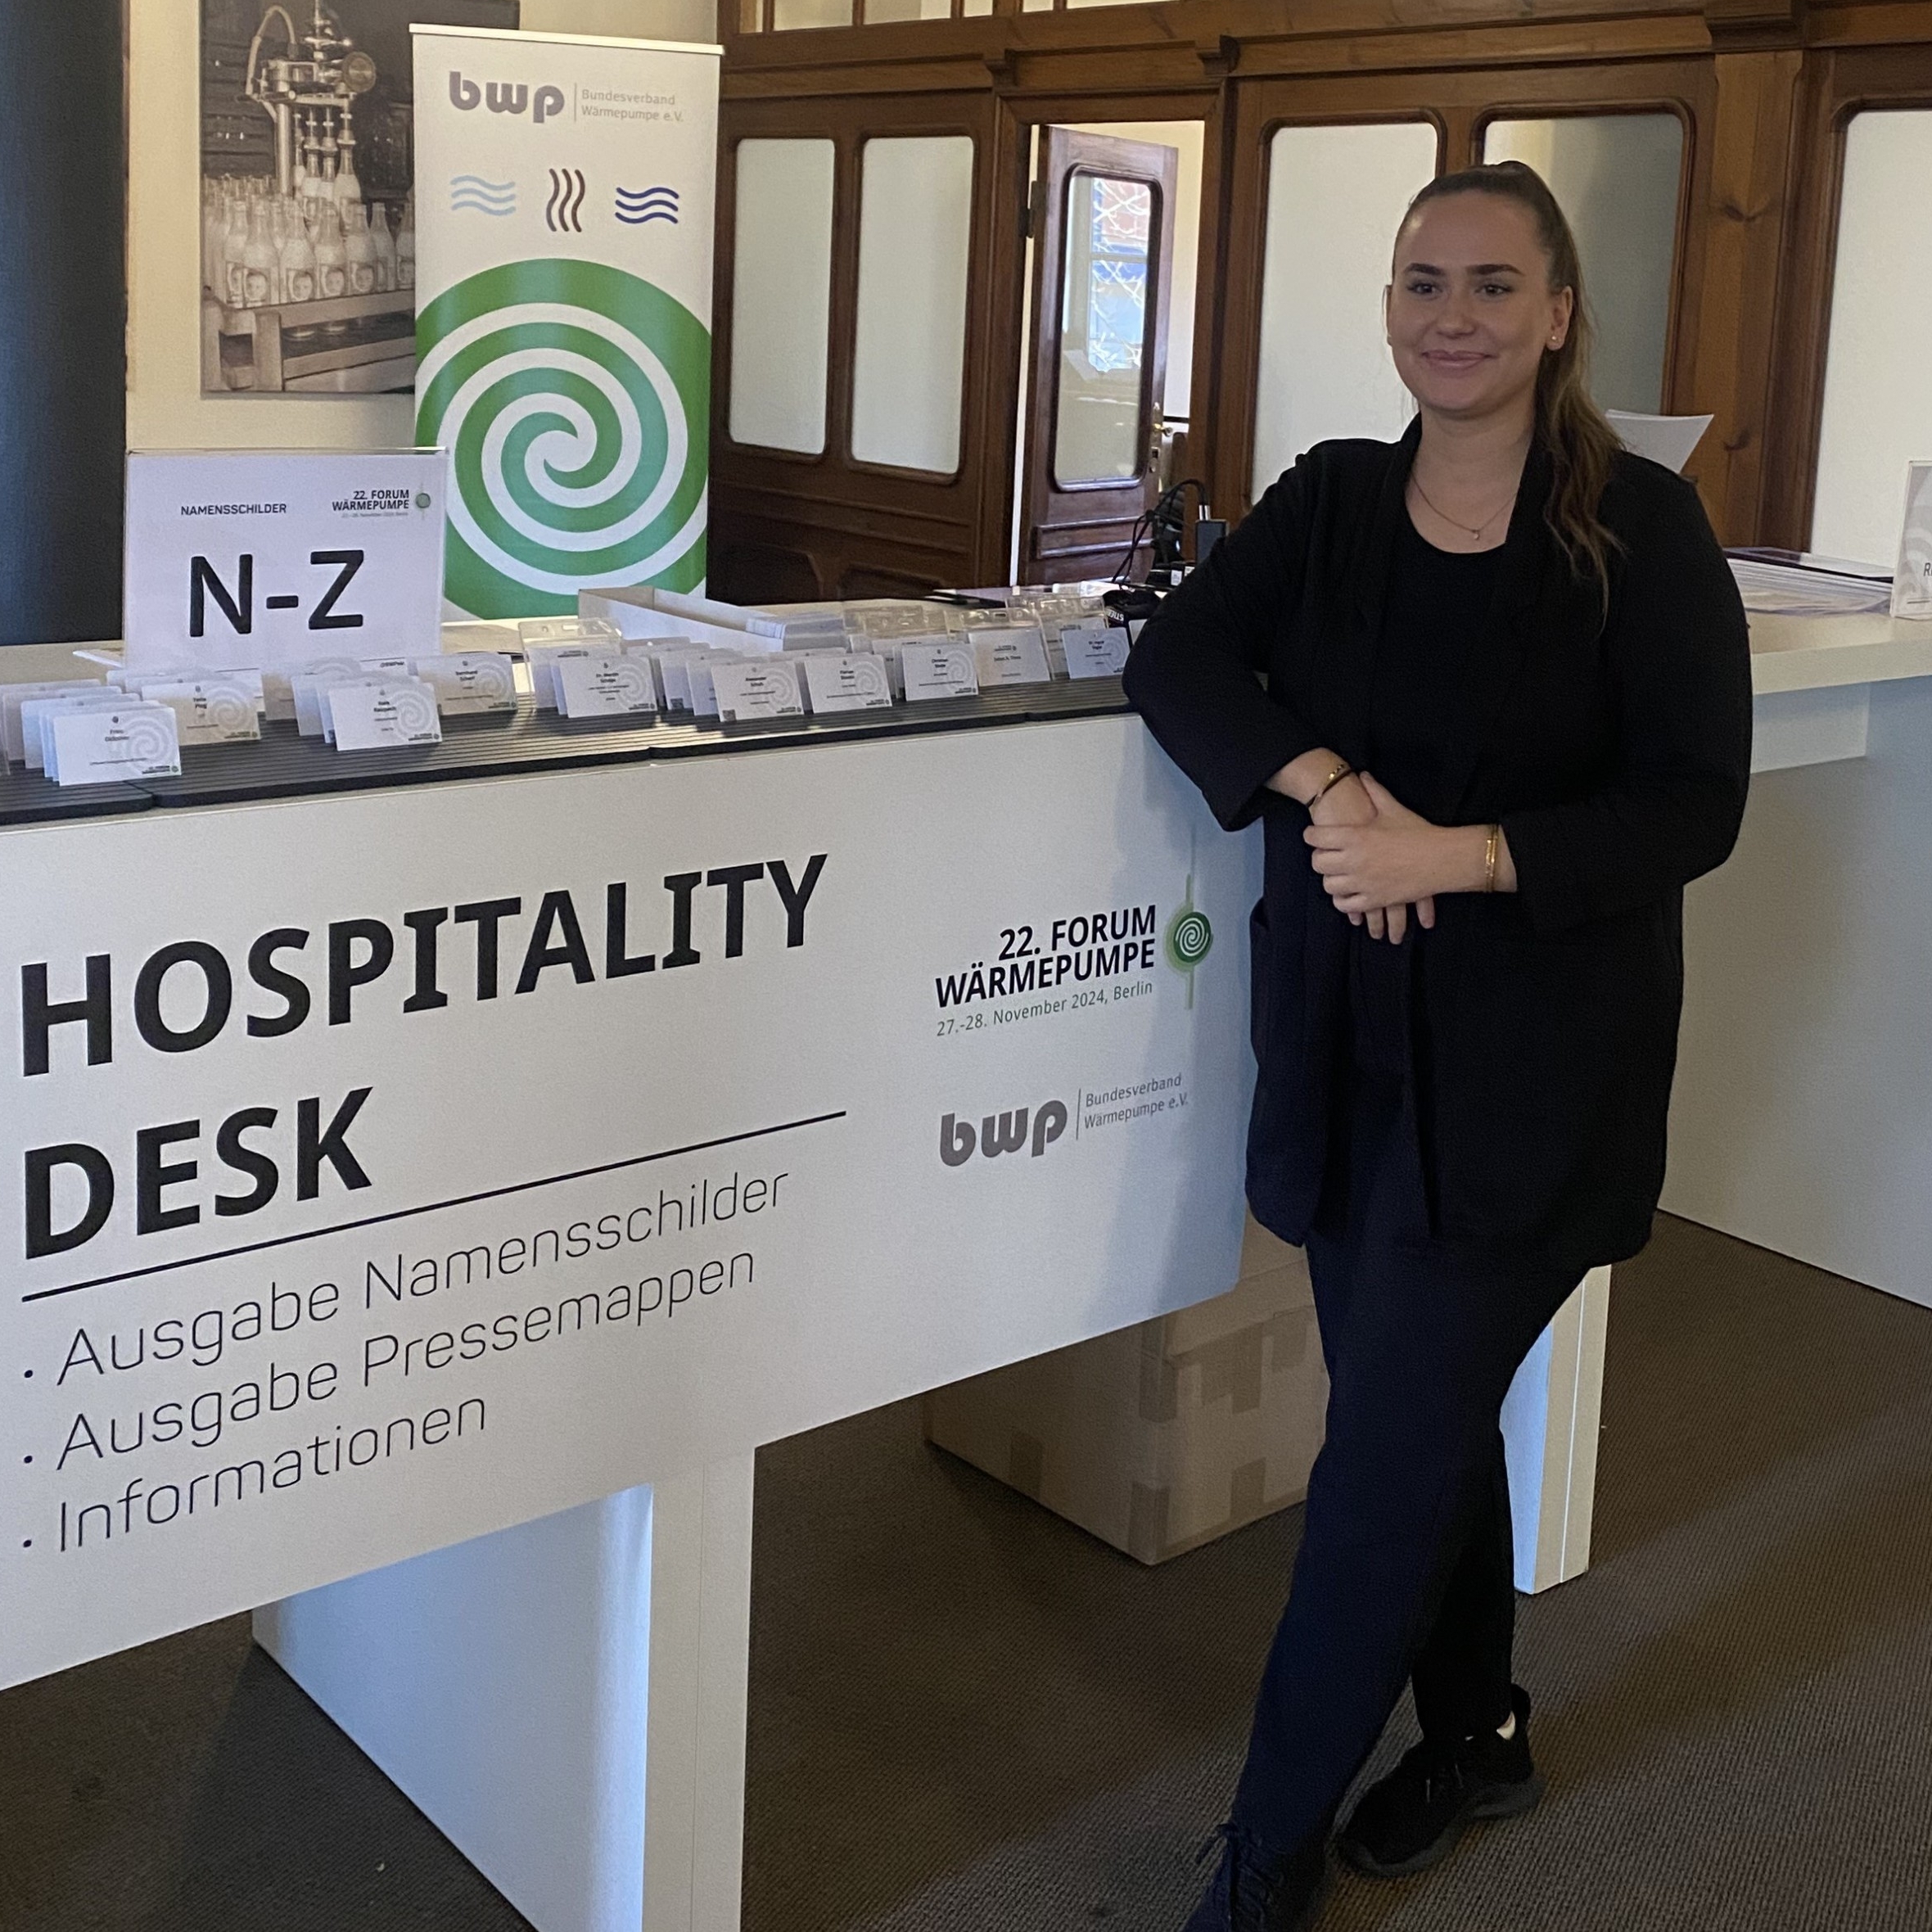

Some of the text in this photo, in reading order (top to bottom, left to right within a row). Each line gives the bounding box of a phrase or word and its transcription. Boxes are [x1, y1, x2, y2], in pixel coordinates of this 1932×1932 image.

[449, 71, 565, 124] bwp
[581, 106, 684, 122] Wärmepumpe e.V.
[582, 89, 675, 106] Bundesverband
[181, 503, 287, 515] NAMENSSCHILDER
[332, 499, 409, 511] WÄRMEPUMPE
[352, 490, 409, 499] 22. FORUM
[999, 905, 1155, 960] 22. FORUM
[22, 854, 828, 1077] HOSPITALITY
[936, 939, 1155, 1008] WÄRMEPUMPE
[937, 982, 1152, 1036] 27.-28. November 2024, Berlin
[1085, 1093, 1188, 1129] Wärmepumpe e.V.
[1086, 1072, 1182, 1107] Bundesverband
[940, 1100, 1068, 1167] bwp
[25, 1087, 373, 1259] DESK
[57, 1173, 788, 1385] Ausgabe Namensschilder
[57, 1253, 752, 1470] Ausgabe Pressemappen
[61, 1399, 485, 1551] Informationen
